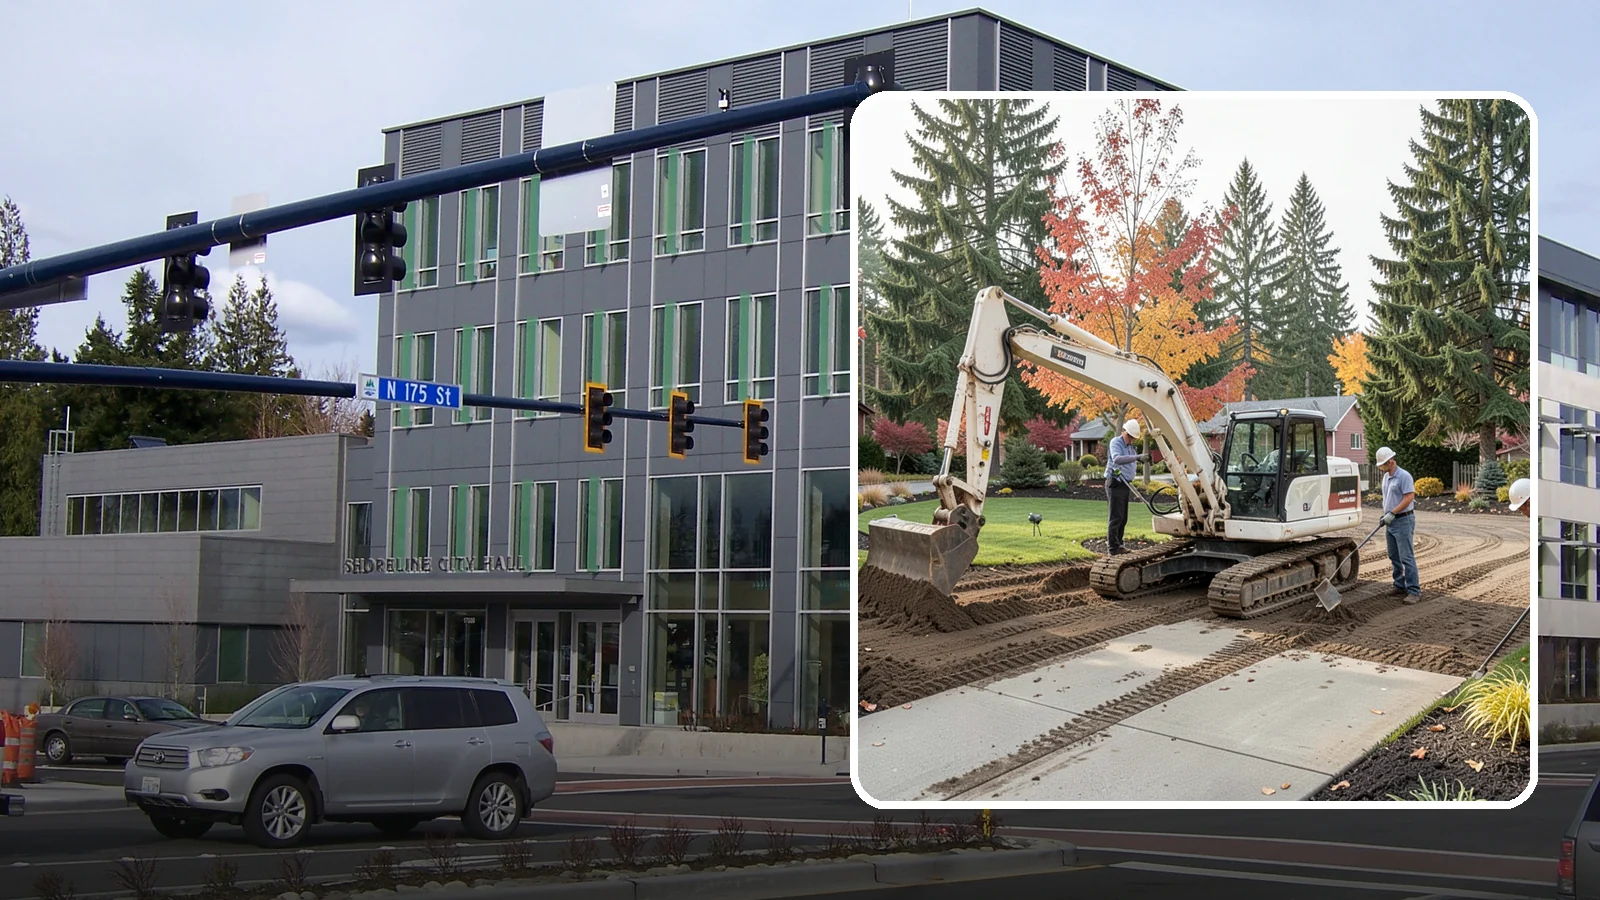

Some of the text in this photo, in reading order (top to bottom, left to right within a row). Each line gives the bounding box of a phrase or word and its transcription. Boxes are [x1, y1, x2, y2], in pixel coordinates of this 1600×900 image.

[387, 380, 451, 405] N 175 St
[344, 555, 525, 574] SHORELINE CITY HALL
